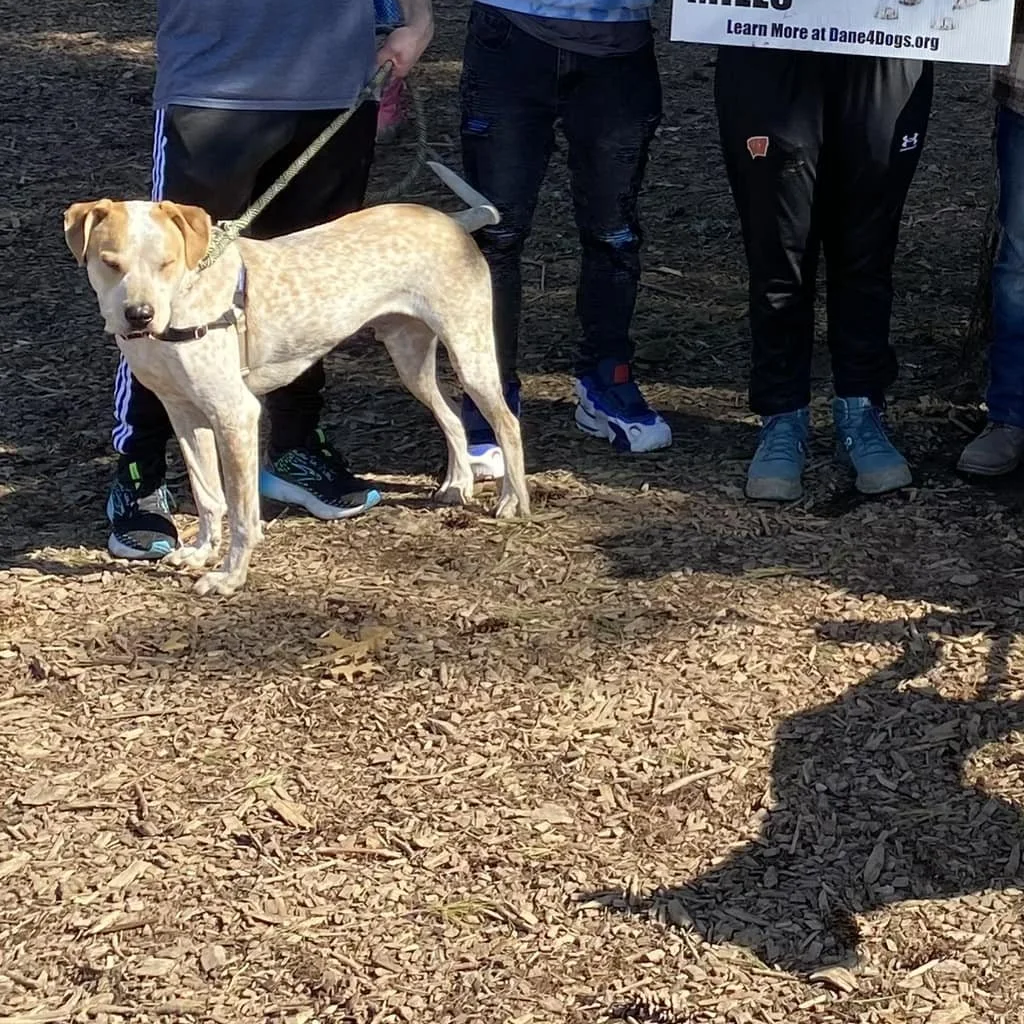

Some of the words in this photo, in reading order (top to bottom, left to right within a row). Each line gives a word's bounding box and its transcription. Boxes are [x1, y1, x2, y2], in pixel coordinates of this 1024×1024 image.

[726, 19, 767, 36] Learn
[771, 23, 808, 39] More
[811, 27, 826, 41] at
[829, 27, 940, 51] Dane4Dogs.org
